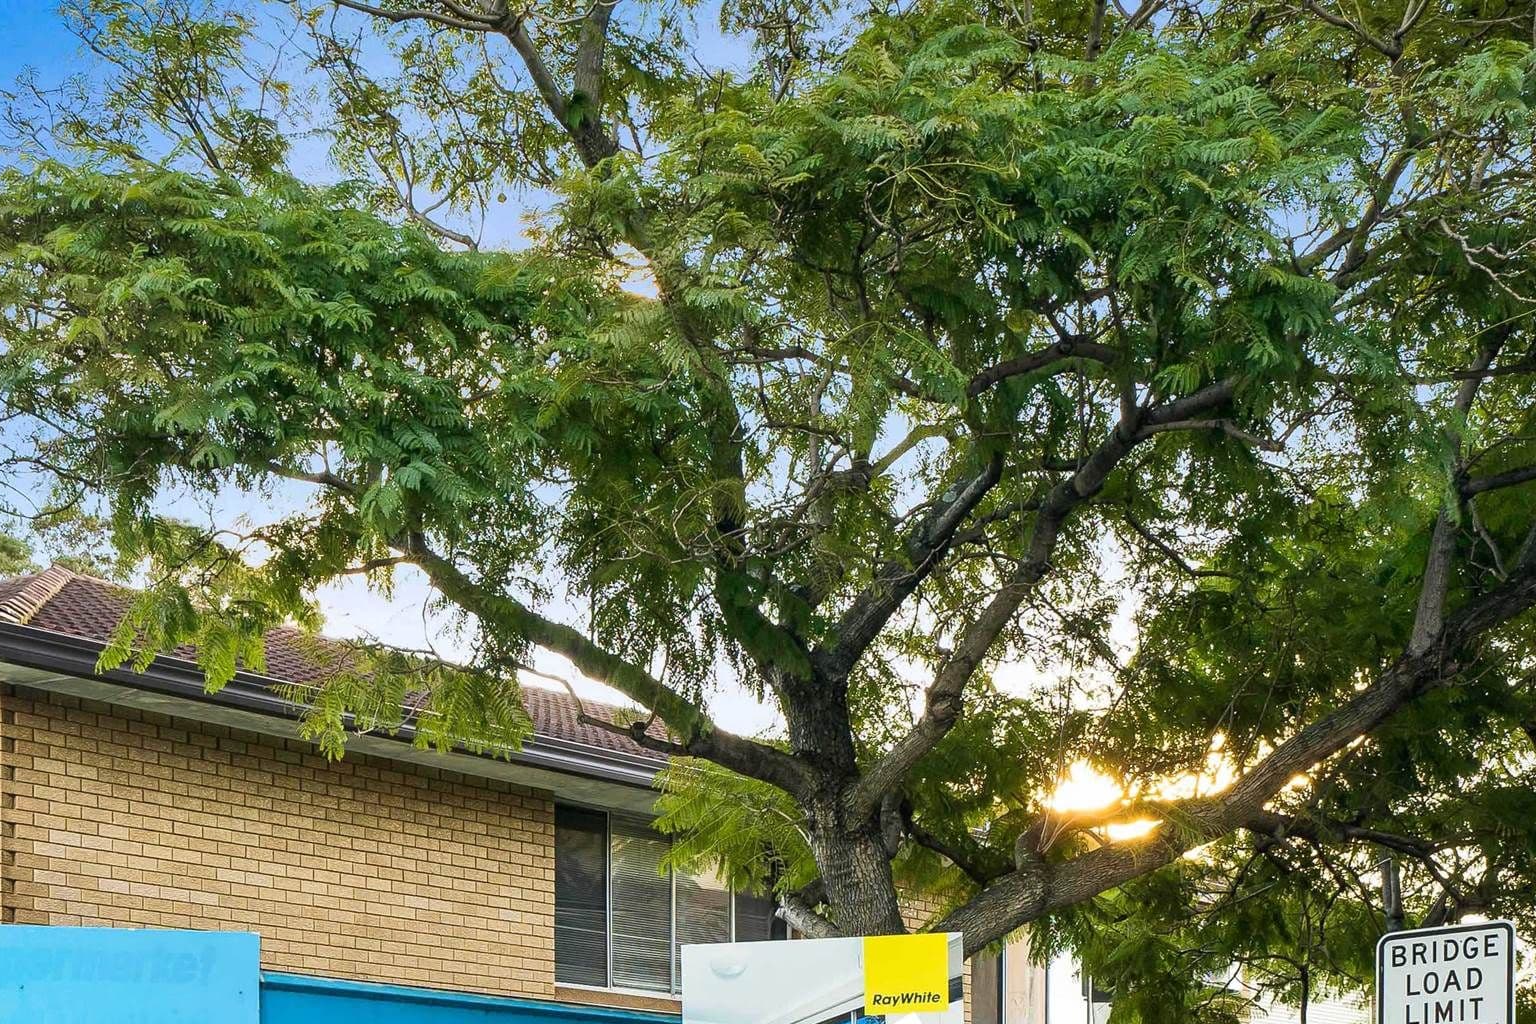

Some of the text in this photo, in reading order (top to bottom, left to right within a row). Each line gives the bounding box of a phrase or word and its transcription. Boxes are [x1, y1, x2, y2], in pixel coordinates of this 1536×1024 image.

[1391, 934, 1499, 968] BRIDGE
[1406, 967, 1483, 996] LOAD
[872, 992, 941, 1007] RayWhite
